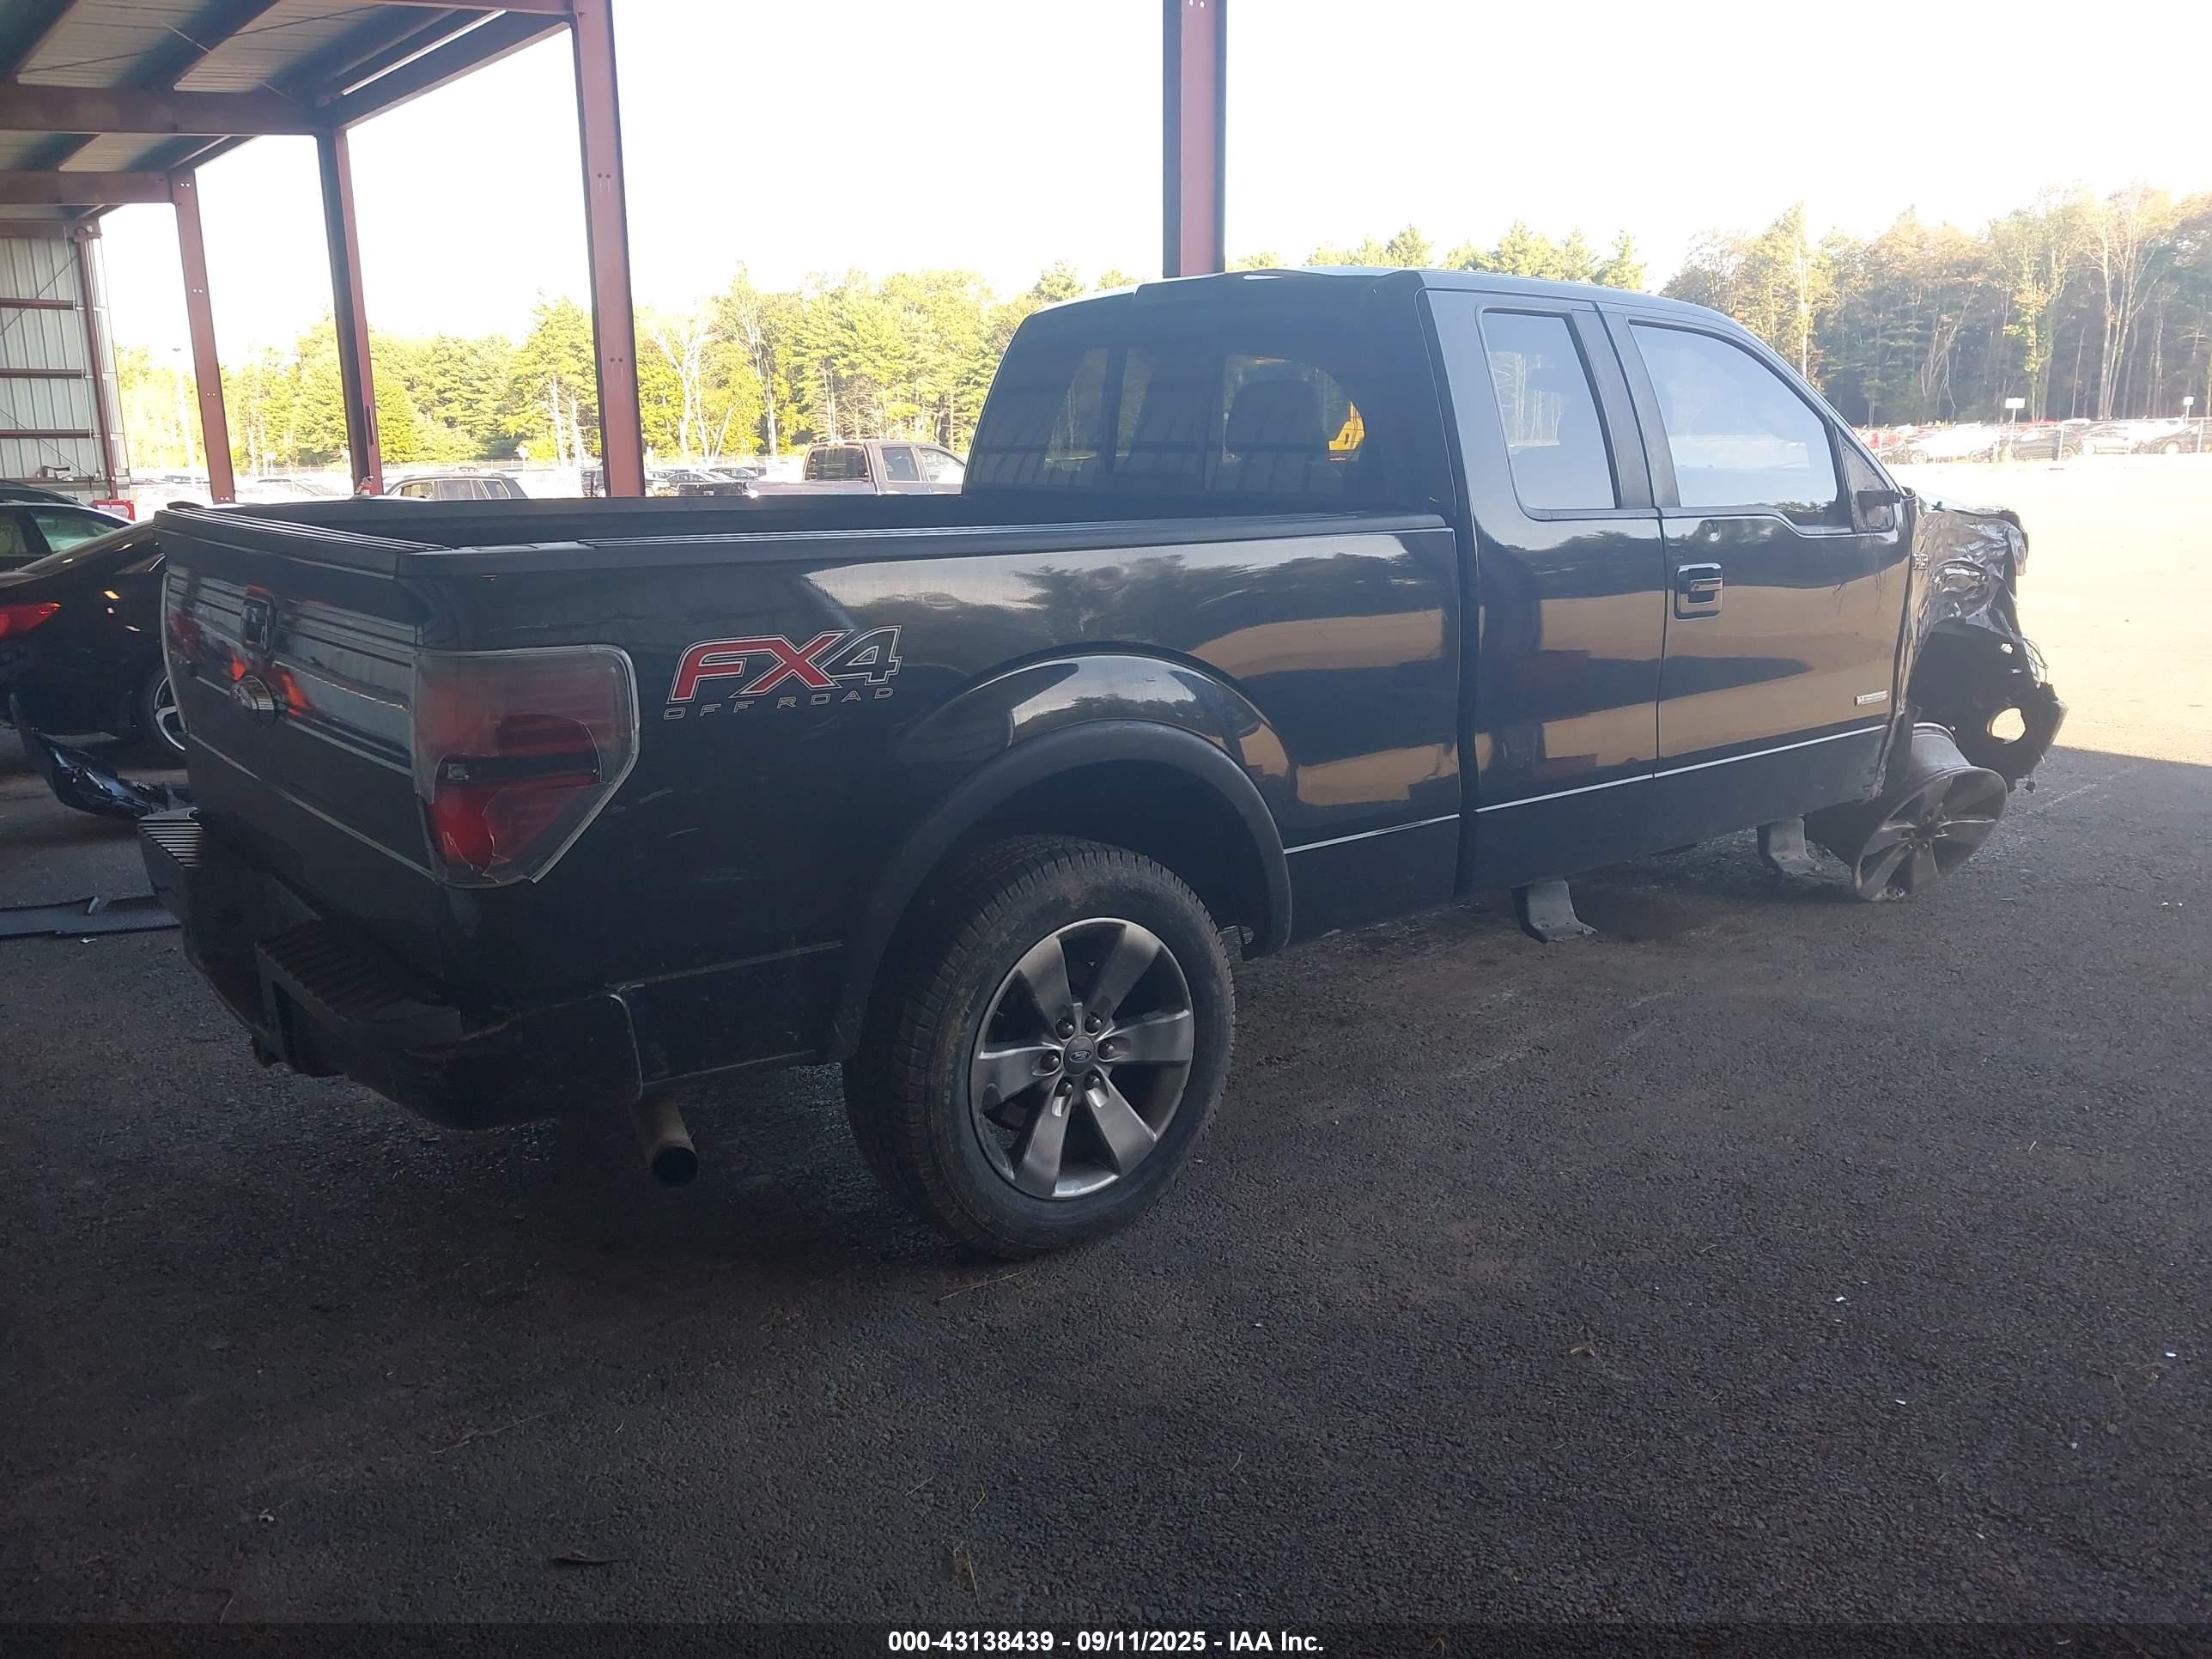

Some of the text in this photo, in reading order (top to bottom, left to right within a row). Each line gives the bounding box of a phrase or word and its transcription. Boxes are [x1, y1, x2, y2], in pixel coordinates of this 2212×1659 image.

[666, 624, 902, 704] FX4
[663, 687, 894, 720] OFF ROAD
